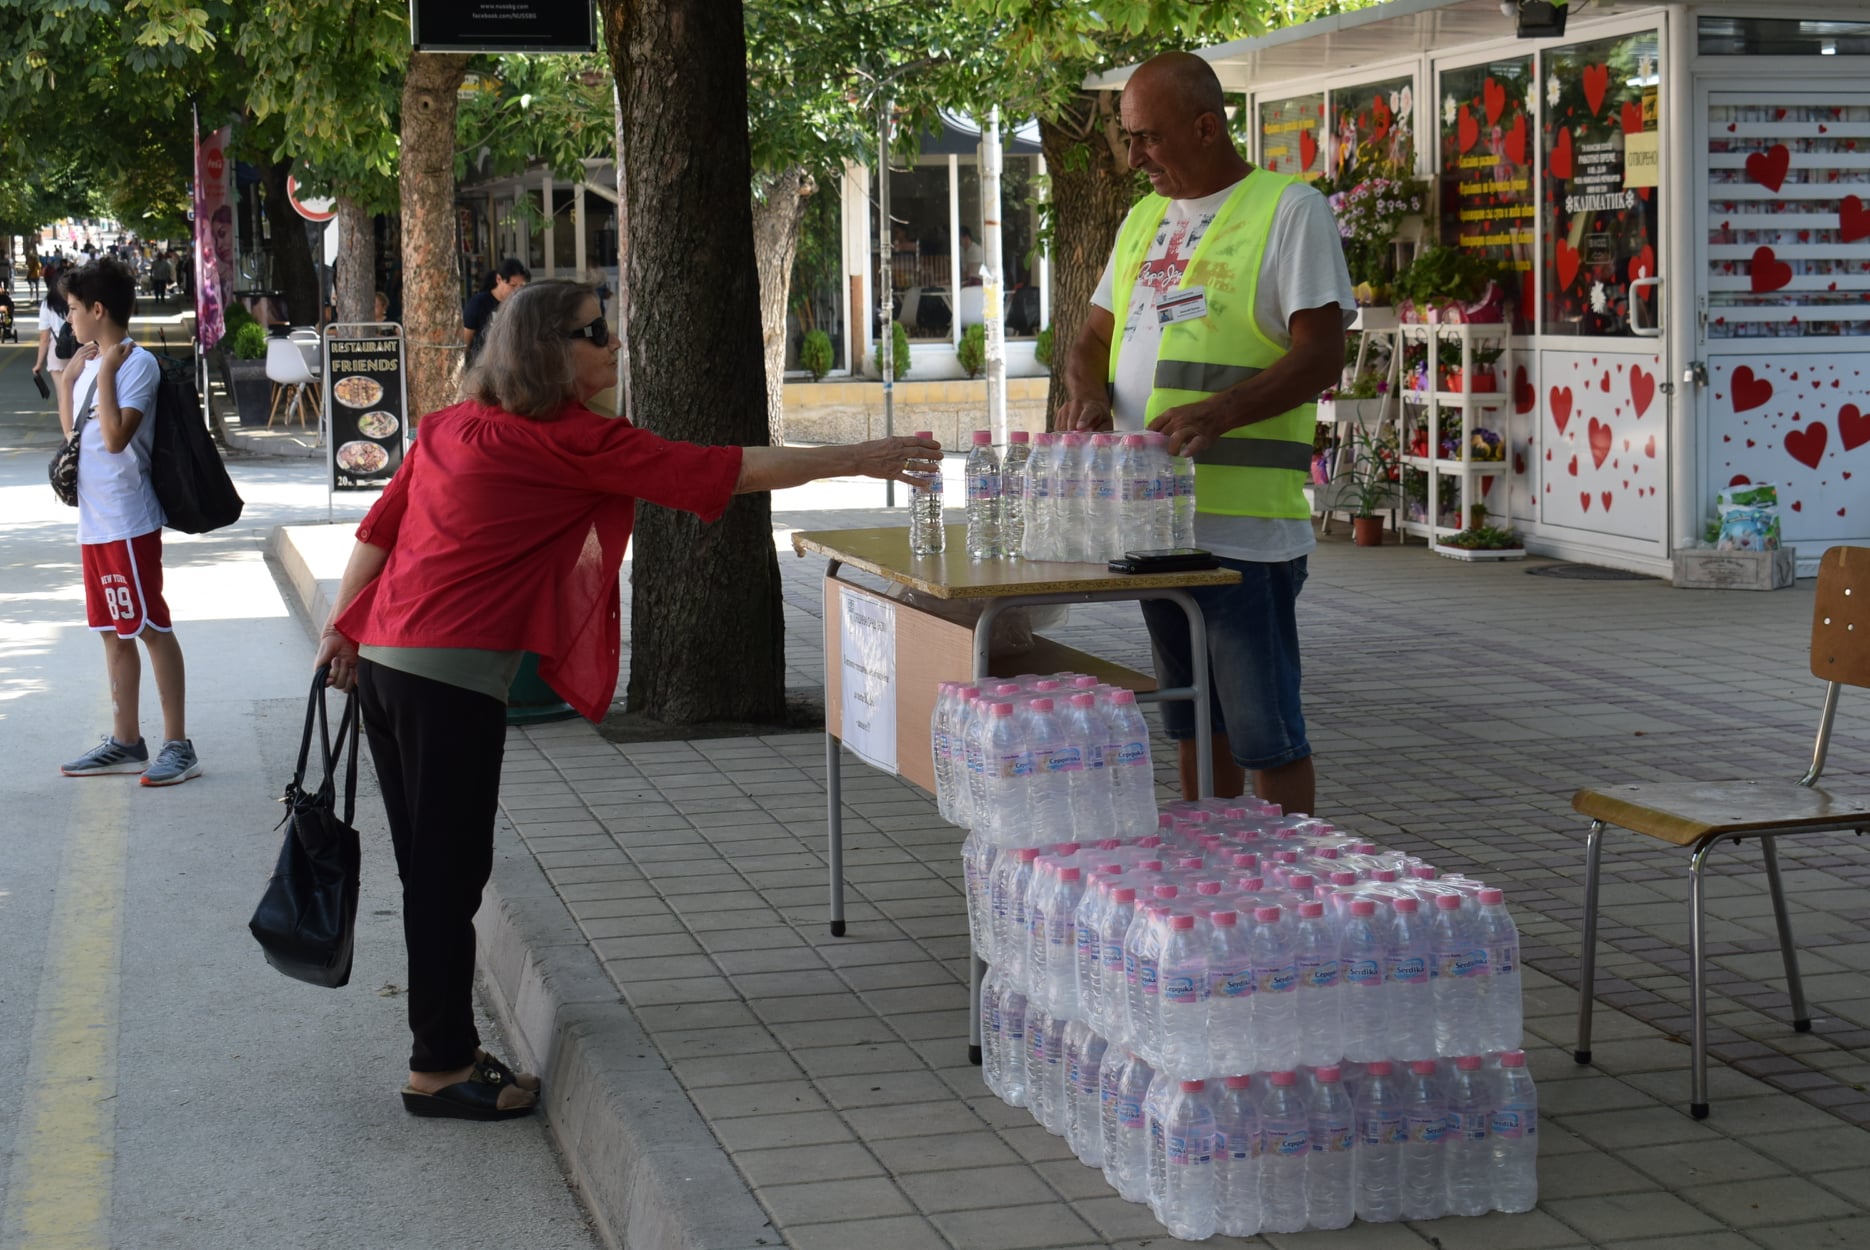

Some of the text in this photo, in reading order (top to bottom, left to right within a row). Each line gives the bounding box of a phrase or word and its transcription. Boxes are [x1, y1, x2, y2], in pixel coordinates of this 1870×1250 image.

[1628, 151, 1658, 167] ОТВОРЕНО
[1574, 192, 1626, 212] КЛИМАТИК
[331, 341, 397, 353] RESTAURANT
[332, 358, 398, 372] FRIENDS
[100, 573, 128, 585] NEW YORK
[105, 586, 135, 620] 89
[1350, 968, 1378, 976] Serdika
[1396, 966, 1425, 974] Serdika
